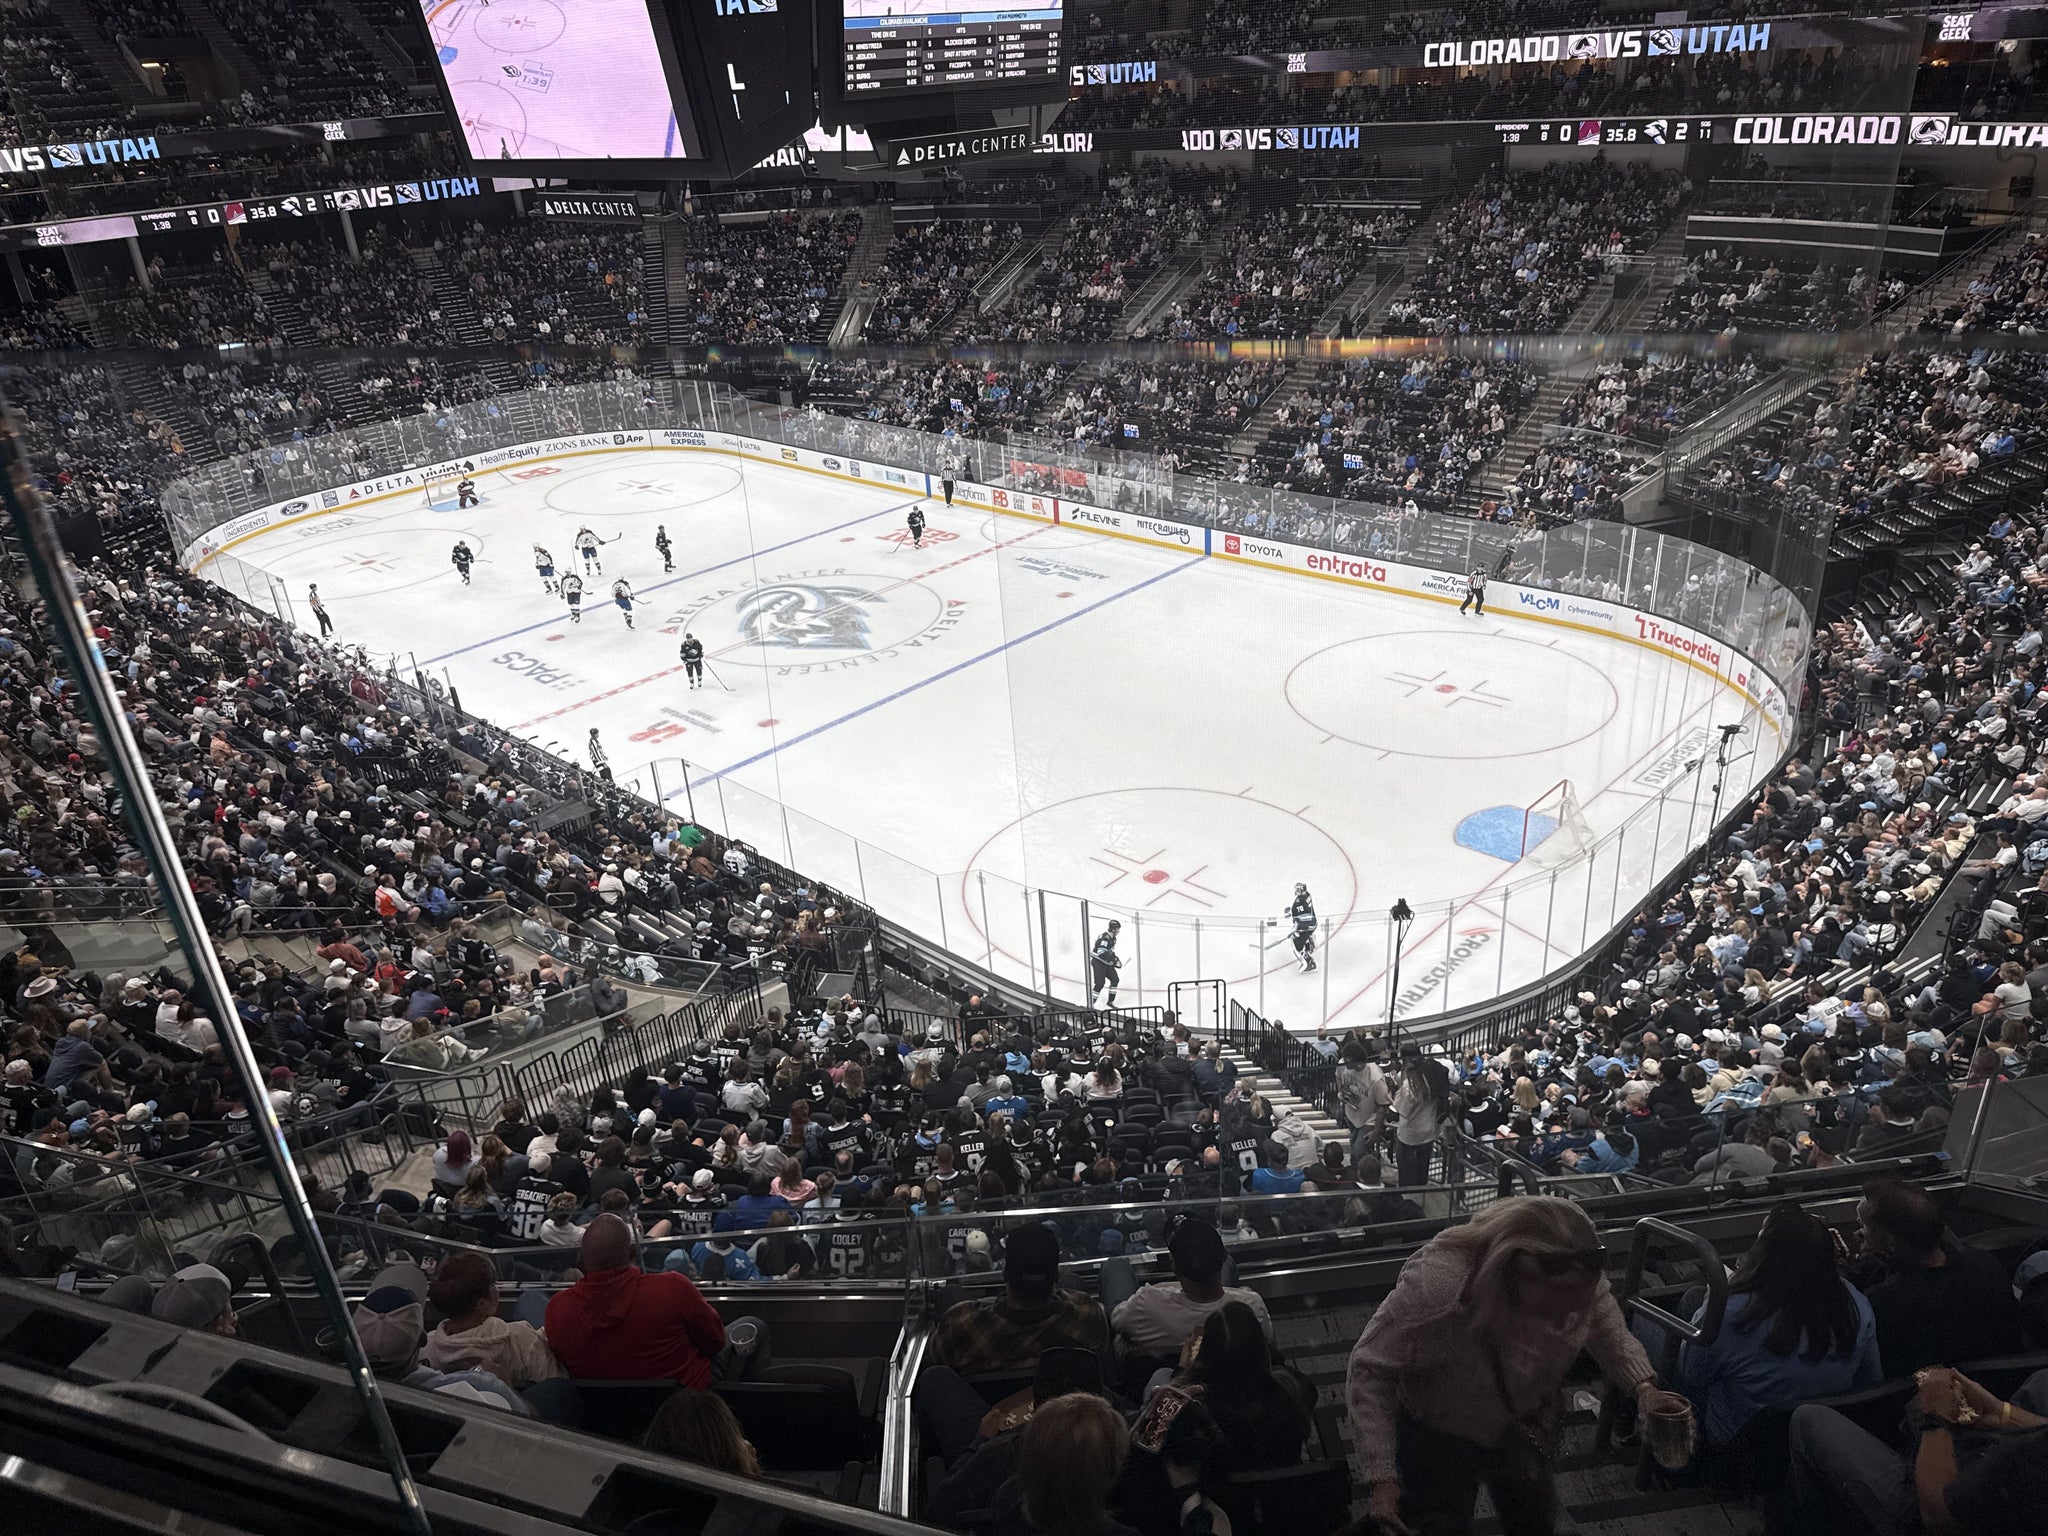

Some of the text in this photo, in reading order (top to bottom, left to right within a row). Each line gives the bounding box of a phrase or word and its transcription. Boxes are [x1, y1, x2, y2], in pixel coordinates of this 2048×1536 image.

[1942, 14, 1973, 28] SEAT
[1939, 27, 1972, 41] GEEK
[1423, 23, 1771, 67] COLORADO VS UTAH
[1288, 53, 1306, 63] SEAT
[1109, 61, 1157, 84] UTAH
[1287, 62, 1306, 72] GEEK
[522, 76, 548, 87] 1:39
[323, 122, 343, 132] SEAT
[1559, 125, 1572, 142] 0
[1675, 122, 1688, 140] 2
[1699, 129, 1711, 139] 11
[1733, 116, 1901, 144] COLORADO
[324, 130, 347, 141] GEEK
[1245, 129, 1271, 150] VS
[1303, 127, 1360, 149] UTAH
[1502, 133, 1520, 143] 1:38
[1541, 132, 1548, 142] 8
[1606, 128, 1637, 142] 35.8
[1, 137, 160, 171] VS UTAH
[914, 134, 1027, 163] DELTA CENTER
[361, 177, 481, 209] VS UTAH
[305, 198, 317, 212] 2
[554, 201, 636, 217] DELTA CENTER
[207, 209, 220, 224] 0
[250, 206, 277, 219] 35.8
[191, 216, 198, 225] 8
[36, 226, 59, 238] SEAT
[38, 235, 63, 247] GEEK
[625, 434, 644, 445] App
[663, 430, 704, 441] AMERICAN
[670, 438, 707, 447] EXPRESS
[545, 436, 609, 452] ZIONS BANK
[743, 442, 761, 452] ULTRA
[480, 445, 540, 466] HealthEquity
[364, 475, 414, 495] DELTA
[225, 521, 238, 531] JUST
[1081, 511, 1121, 527] FILEVINE
[227, 517, 267, 538] INGREDIENTS
[1137, 519, 1190, 544] NITECRAWLER
[1243, 543, 1283, 559] TOYOTA
[1307, 554, 1387, 583] entrata
[1421, 580, 1456, 593] AMERICA
[667, 567, 847, 625] DELTA CENTER
[1519, 592, 1613, 621] VLCM Cybersecurity
[777, 609, 964, 677] DELTA CENTER
[1649, 622, 1720, 666] Trucordia
[960, 1142, 985, 1154] KELLER
[1231, 1138, 1258, 1152] KELLER
[516, 1189, 550, 1202] SERGACHEV
[512, 1202, 545, 1240] 98
[832, 1233, 862, 1246] COOLEY
[829, 1247, 864, 1275] 92
